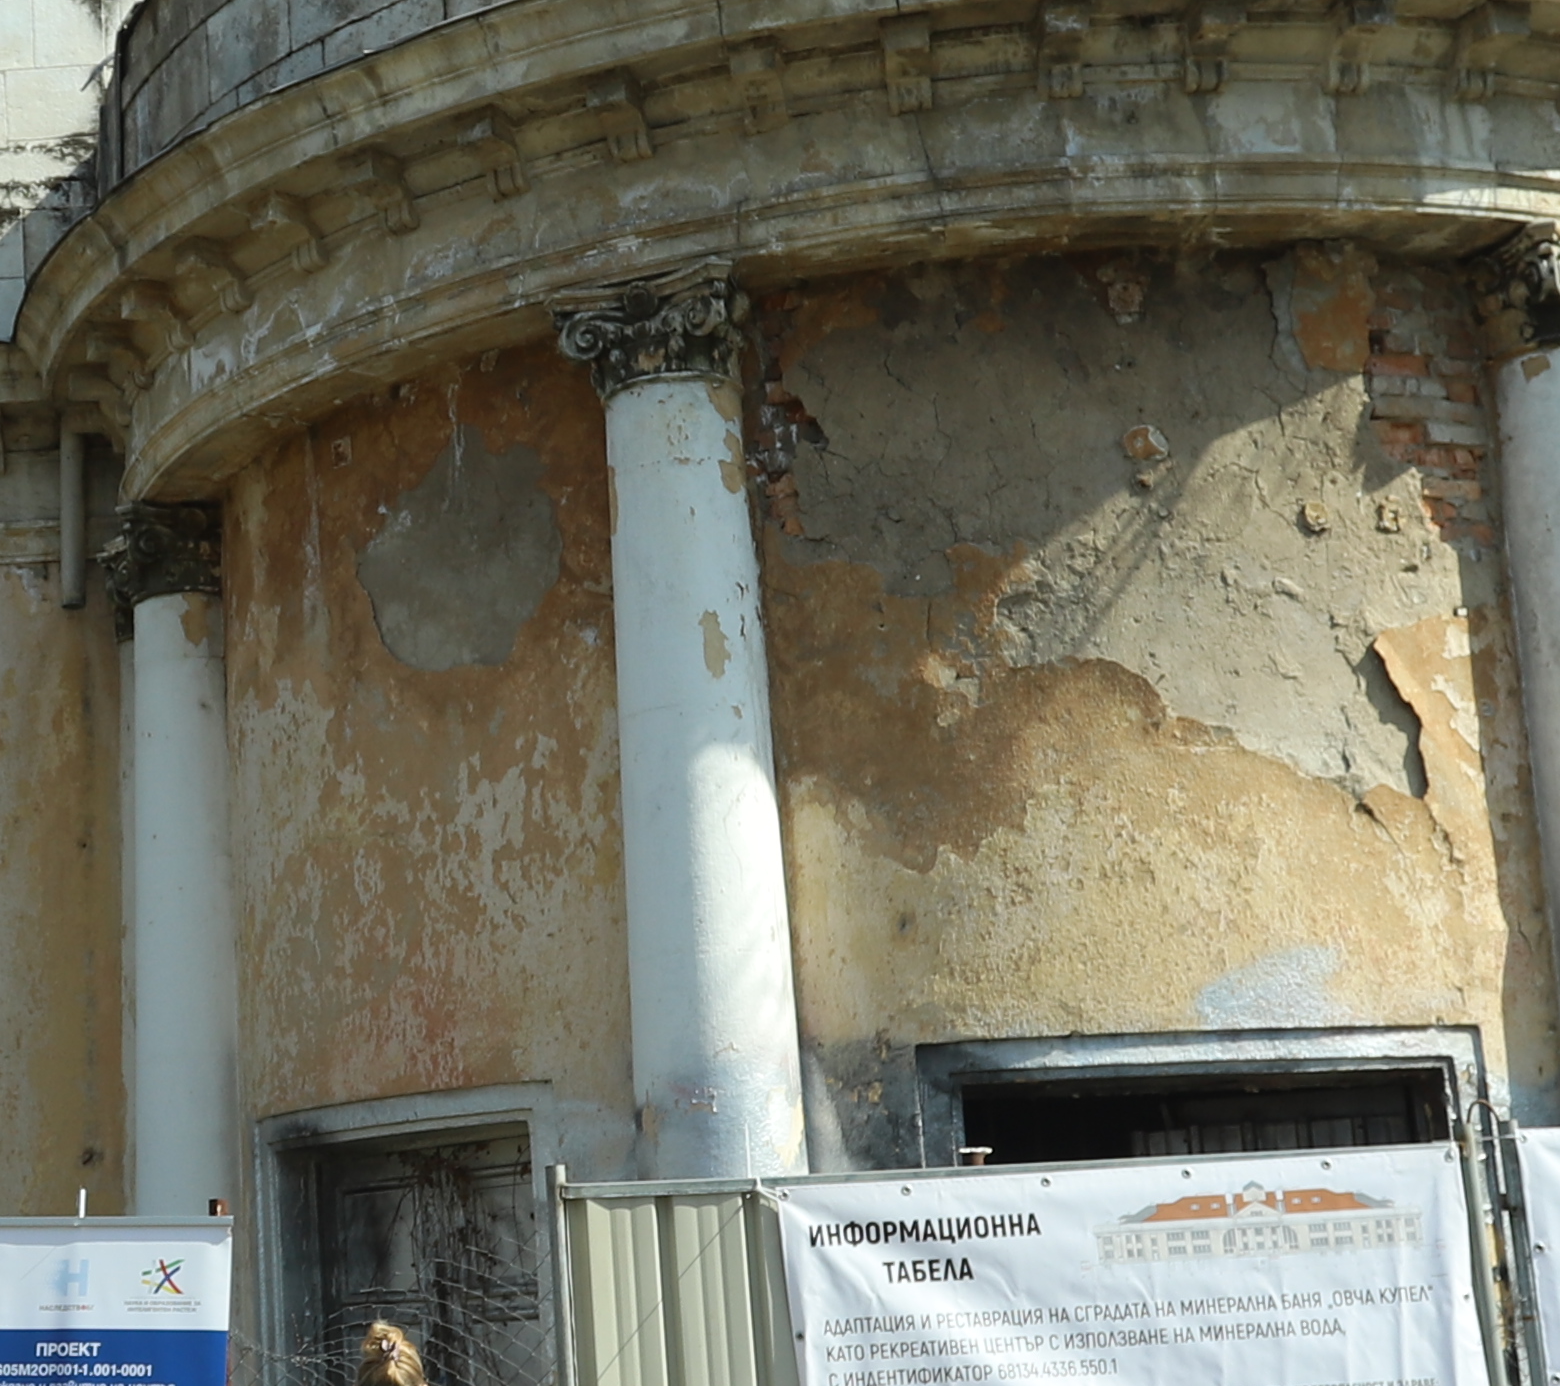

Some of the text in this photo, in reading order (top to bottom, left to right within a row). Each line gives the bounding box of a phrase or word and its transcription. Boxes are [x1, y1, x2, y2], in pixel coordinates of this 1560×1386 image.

[809, 1213, 1041, 1247] ИНФОРМАЦИОННА
[883, 1257, 974, 1283] ТАБЕЛА
[824, 1314, 915, 1337] АДАПТАЦИЯ
[921, 1313, 931, 1329] И
[937, 1307, 1043, 1331] РЕСТАВРАЦИЯ
[1049, 1305, 1070, 1322] НА
[1075, 1301, 1150, 1323] СГРАДАТА
[1156, 1299, 1175, 1316] НА
[1181, 1293, 1276, 1315] МИНЕРАЛНА
[1282, 1291, 1321, 1309] БАНЯ
[36, 1342, 101, 1357] ПРОЕКТ
[827, 1318, 1345, 1361] КАТО РЕКРЕАТИВЕН ЦЕНТЪР С ИЗПОЛЗВАНЕ НА МИНЕРАЛНА ВОДА,
[998, 1359, 1117, 1381] 68134.4336.550.1
